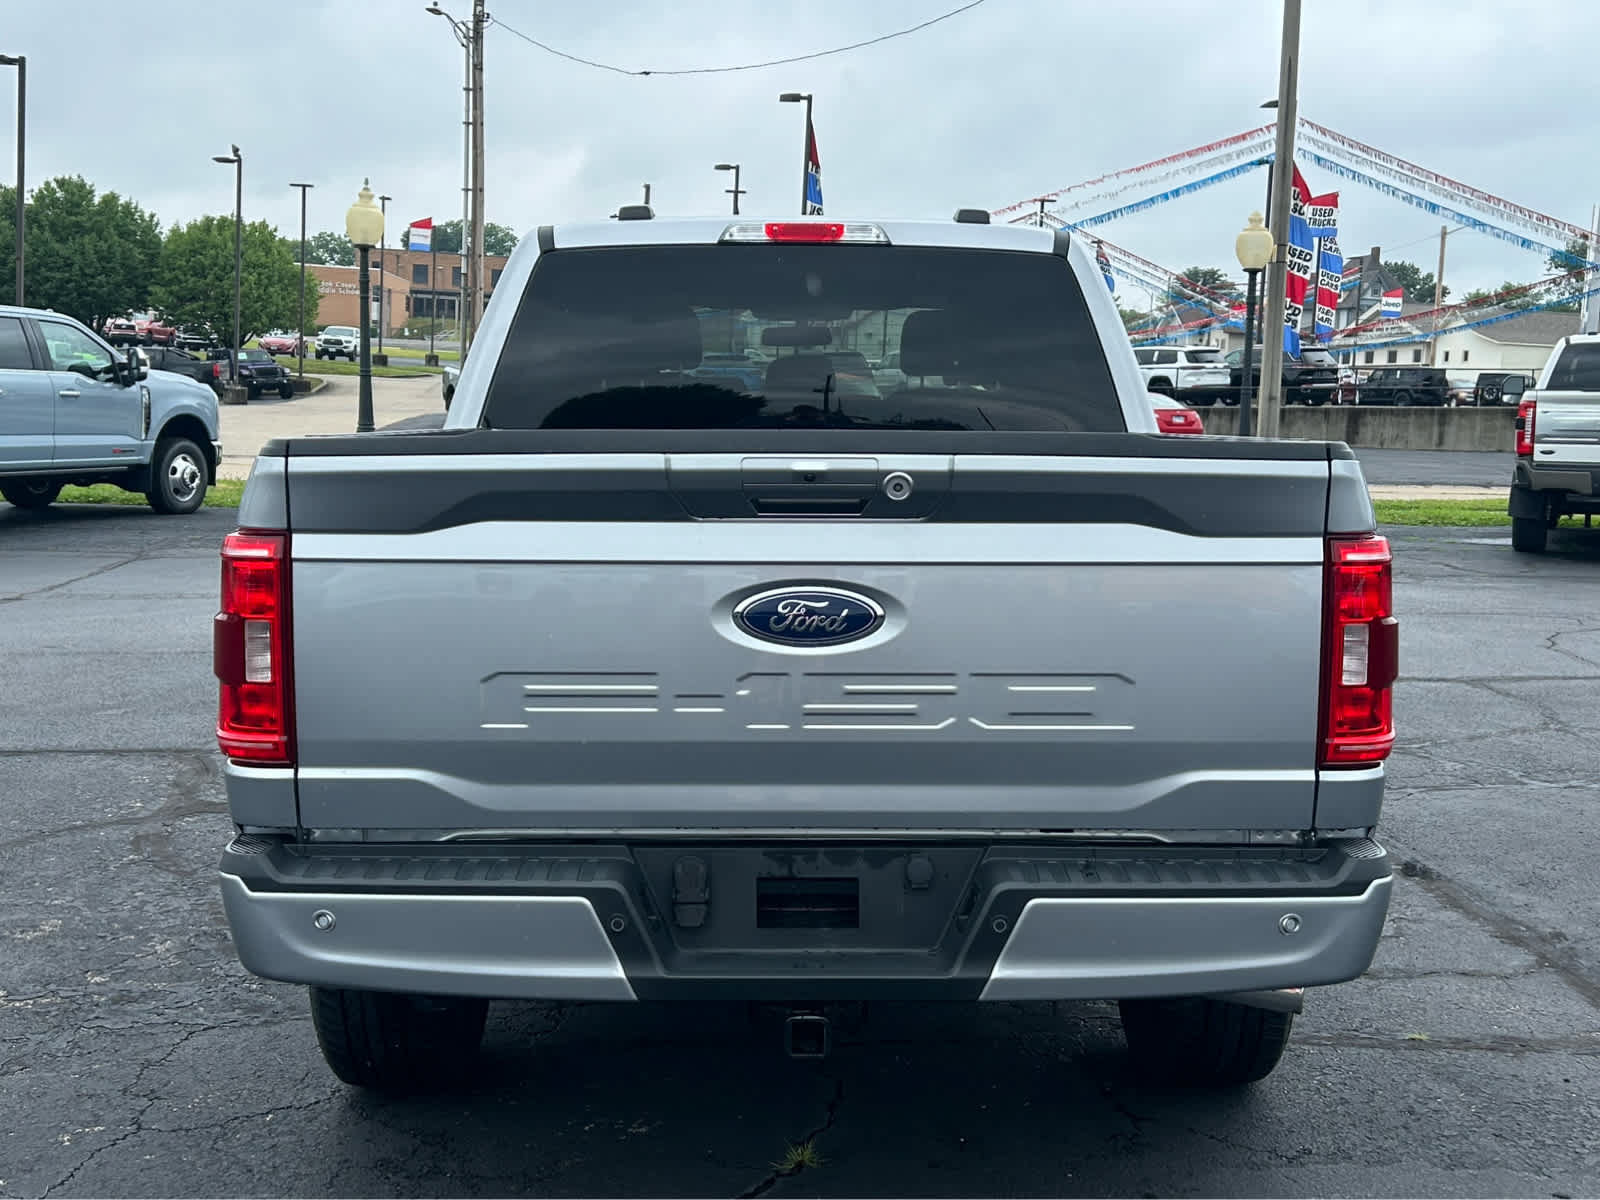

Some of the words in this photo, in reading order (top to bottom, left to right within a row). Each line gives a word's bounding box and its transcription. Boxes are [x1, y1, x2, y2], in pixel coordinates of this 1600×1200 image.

[1312, 207, 1334, 217] USED
[1308, 217, 1337, 227] TRUCKS
[1321, 270, 1340, 283] USED
[1382, 300, 1401, 308] Jeep
[769, 599, 849, 633] Ford
[480, 671, 1135, 730] F-150
